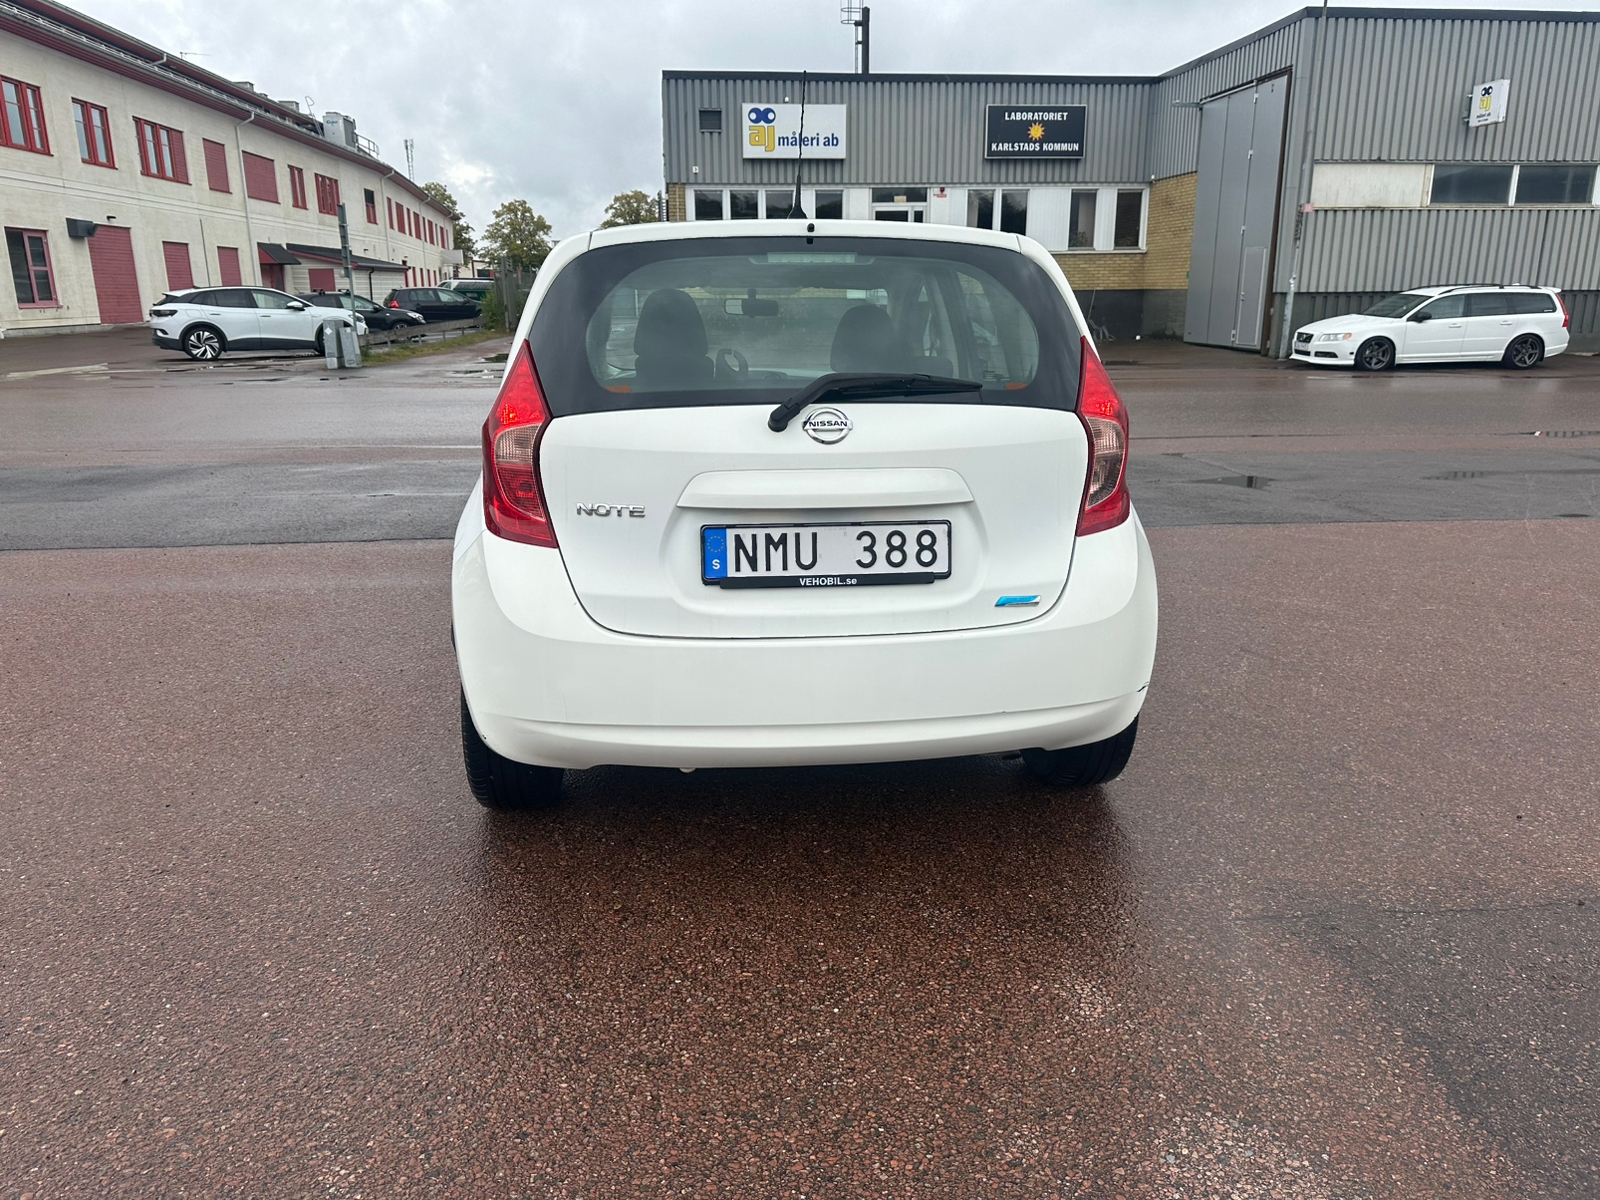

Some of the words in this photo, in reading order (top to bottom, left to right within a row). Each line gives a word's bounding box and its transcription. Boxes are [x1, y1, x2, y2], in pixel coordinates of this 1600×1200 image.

[1004, 111, 1069, 121] LABORATORIET
[748, 125, 775, 152] aj
[777, 131, 820, 147] måleri
[822, 133, 839, 147] ab
[991, 142, 1040, 151] KARLSTADS
[1042, 142, 1079, 151] KOMMUN
[576, 502, 646, 518] NOTE
[733, 531, 818, 572] NMU
[855, 529, 938, 569] 388
[711, 558, 721, 570] S
[799, 576, 858, 586] VEHOBIL.se
